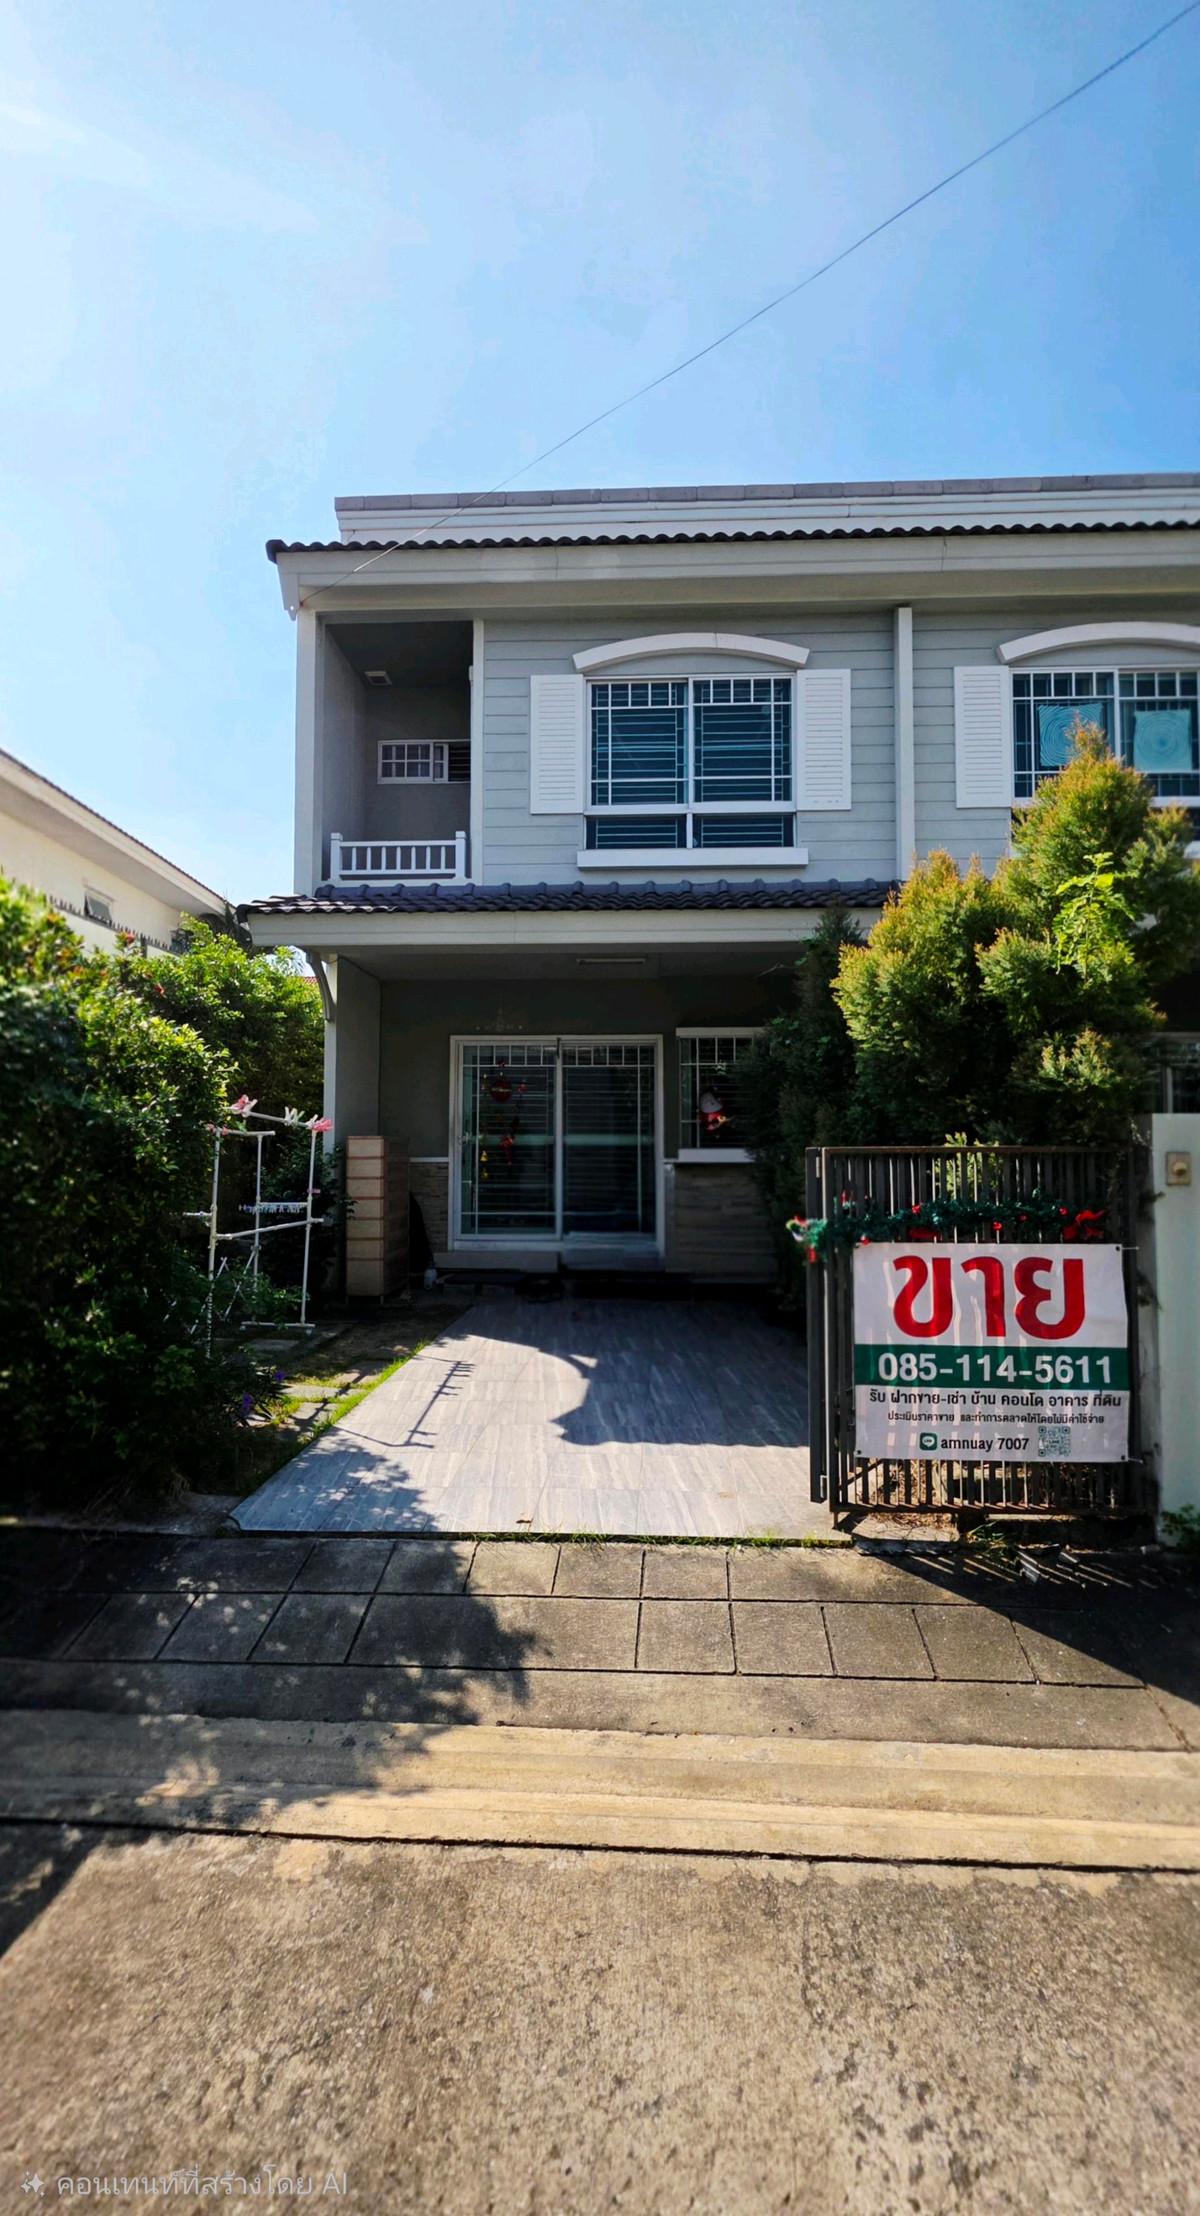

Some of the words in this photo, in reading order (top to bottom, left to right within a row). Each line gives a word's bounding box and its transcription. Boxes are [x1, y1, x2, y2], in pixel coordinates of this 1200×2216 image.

[892, 1255, 1086, 1340] ขาย
[878, 1352, 1111, 1384] 085-114-5611
[870, 1388, 886, 1403] รับ
[891, 1389, 967, 1405] ฝากขาย-เช่า
[971, 1391, 996, 1405] บ้าน
[1001, 1392, 1044, 1407] คอนโด
[1049, 1395, 1089, 1407] อาคาร
[1093, 1391, 1122, 1407] ที่ดิน
[888, 1411, 955, 1422] ประเมินราคาขาย
[941, 1438, 993, 1452] amnuay
[997, 1438, 1029, 1450] 7007
